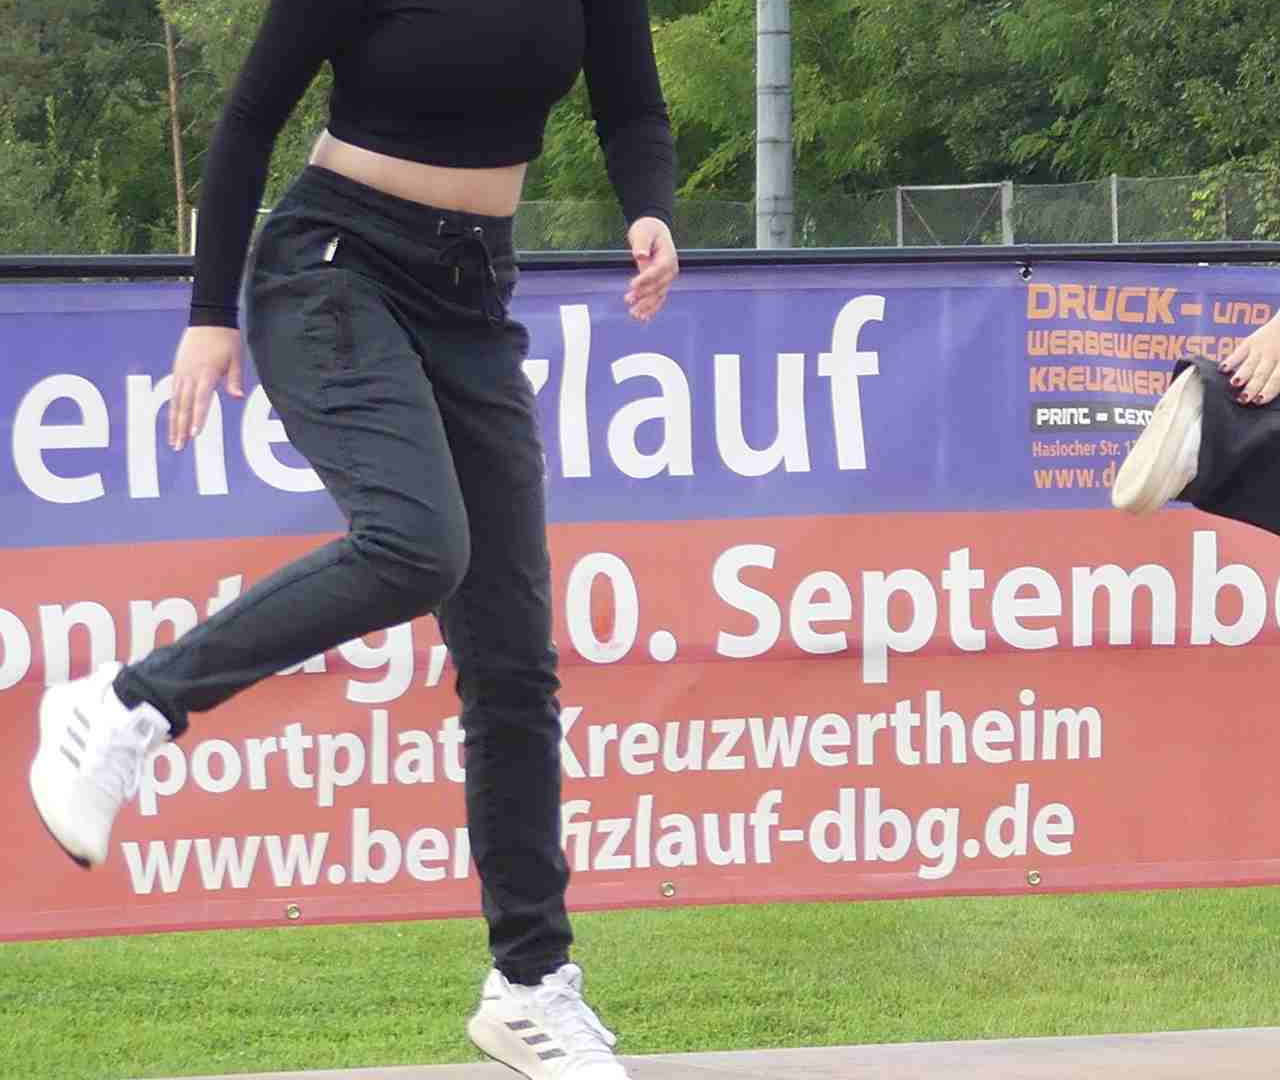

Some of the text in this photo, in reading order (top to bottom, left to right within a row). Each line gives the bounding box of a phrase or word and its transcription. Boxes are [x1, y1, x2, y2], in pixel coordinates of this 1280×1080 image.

[1027, 329, 1247, 360] WERBEWERKSTA
[1029, 365, 1172, 396] KREUZWER
[1033, 459, 1116, 489] www.d
[565, 552, 678, 665] 0.
[137, 709, 466, 816] portplat
